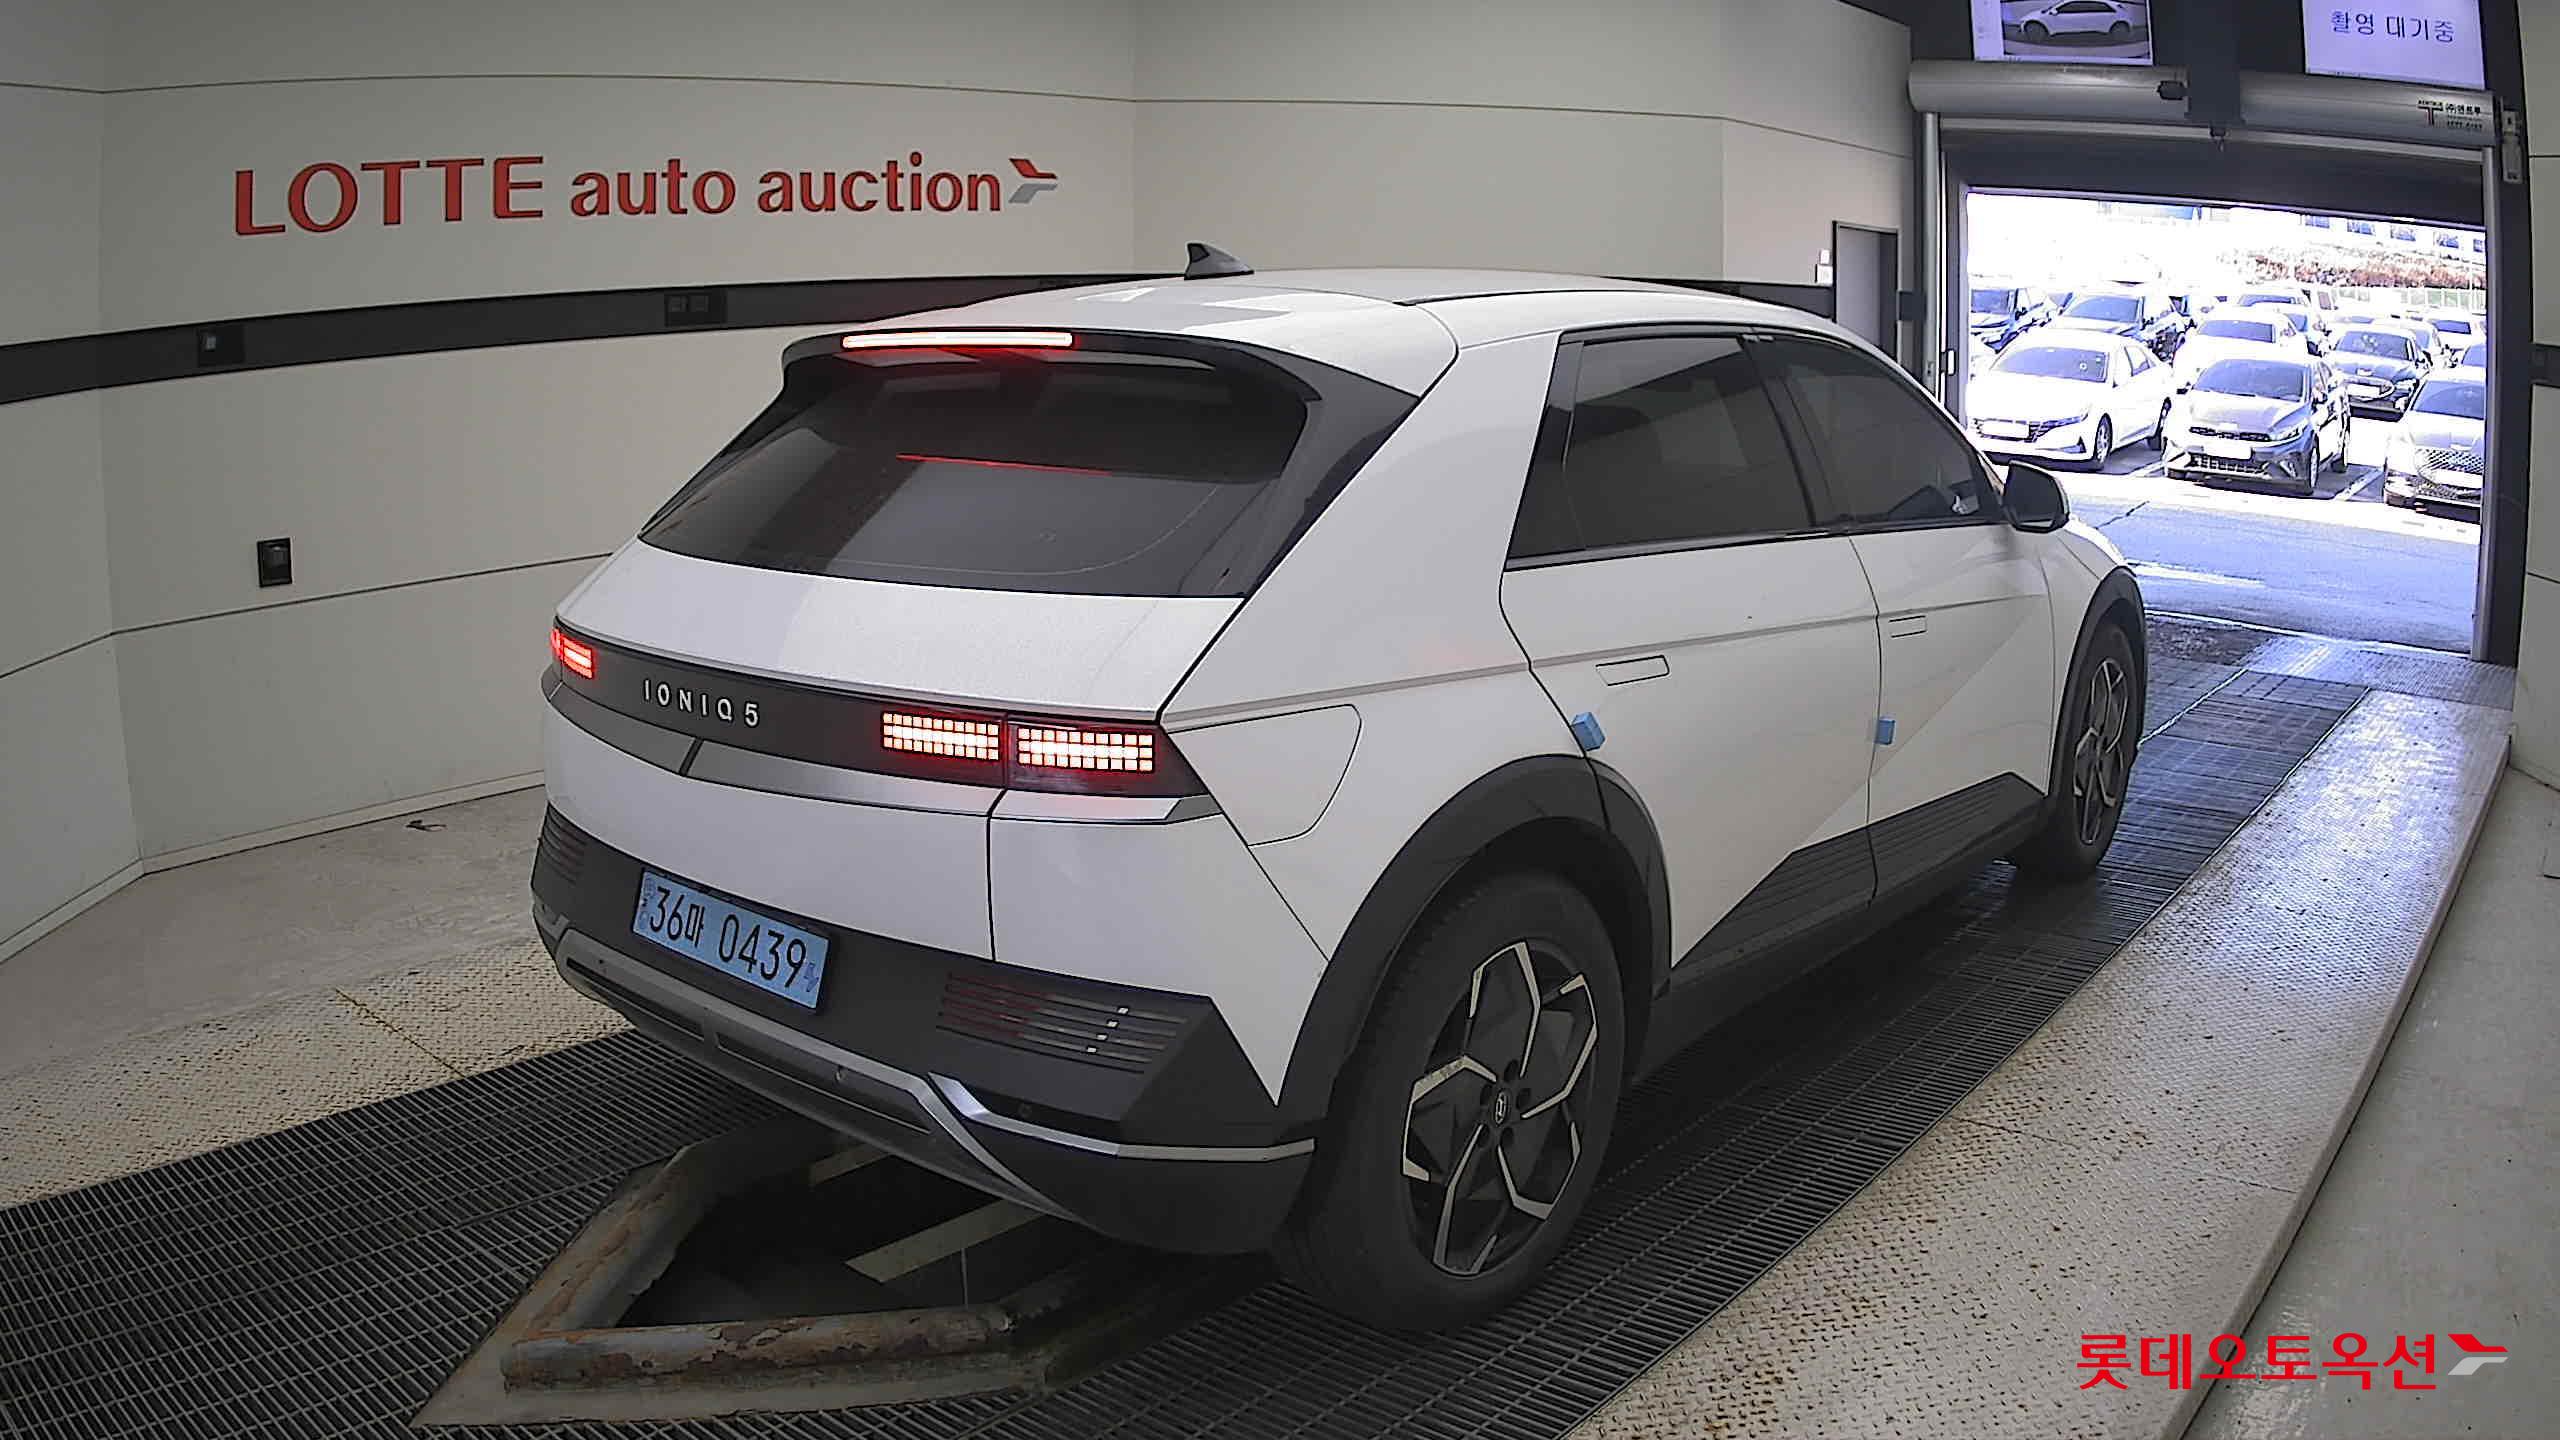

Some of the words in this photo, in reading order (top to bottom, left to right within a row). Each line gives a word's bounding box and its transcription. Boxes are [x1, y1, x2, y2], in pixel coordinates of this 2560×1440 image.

[2331, 10, 2374, 35] 촬영
[2386, 16, 2454, 43] 대기중
[235, 155, 544, 235] LOTTE
[570, 157, 737, 217] auto
[757, 151, 1001, 213] auction
[643, 679, 733, 722] IONIQ
[744, 702, 759, 727] 5
[649, 885, 705, 948] 36마
[718, 913, 807, 988] 0439
